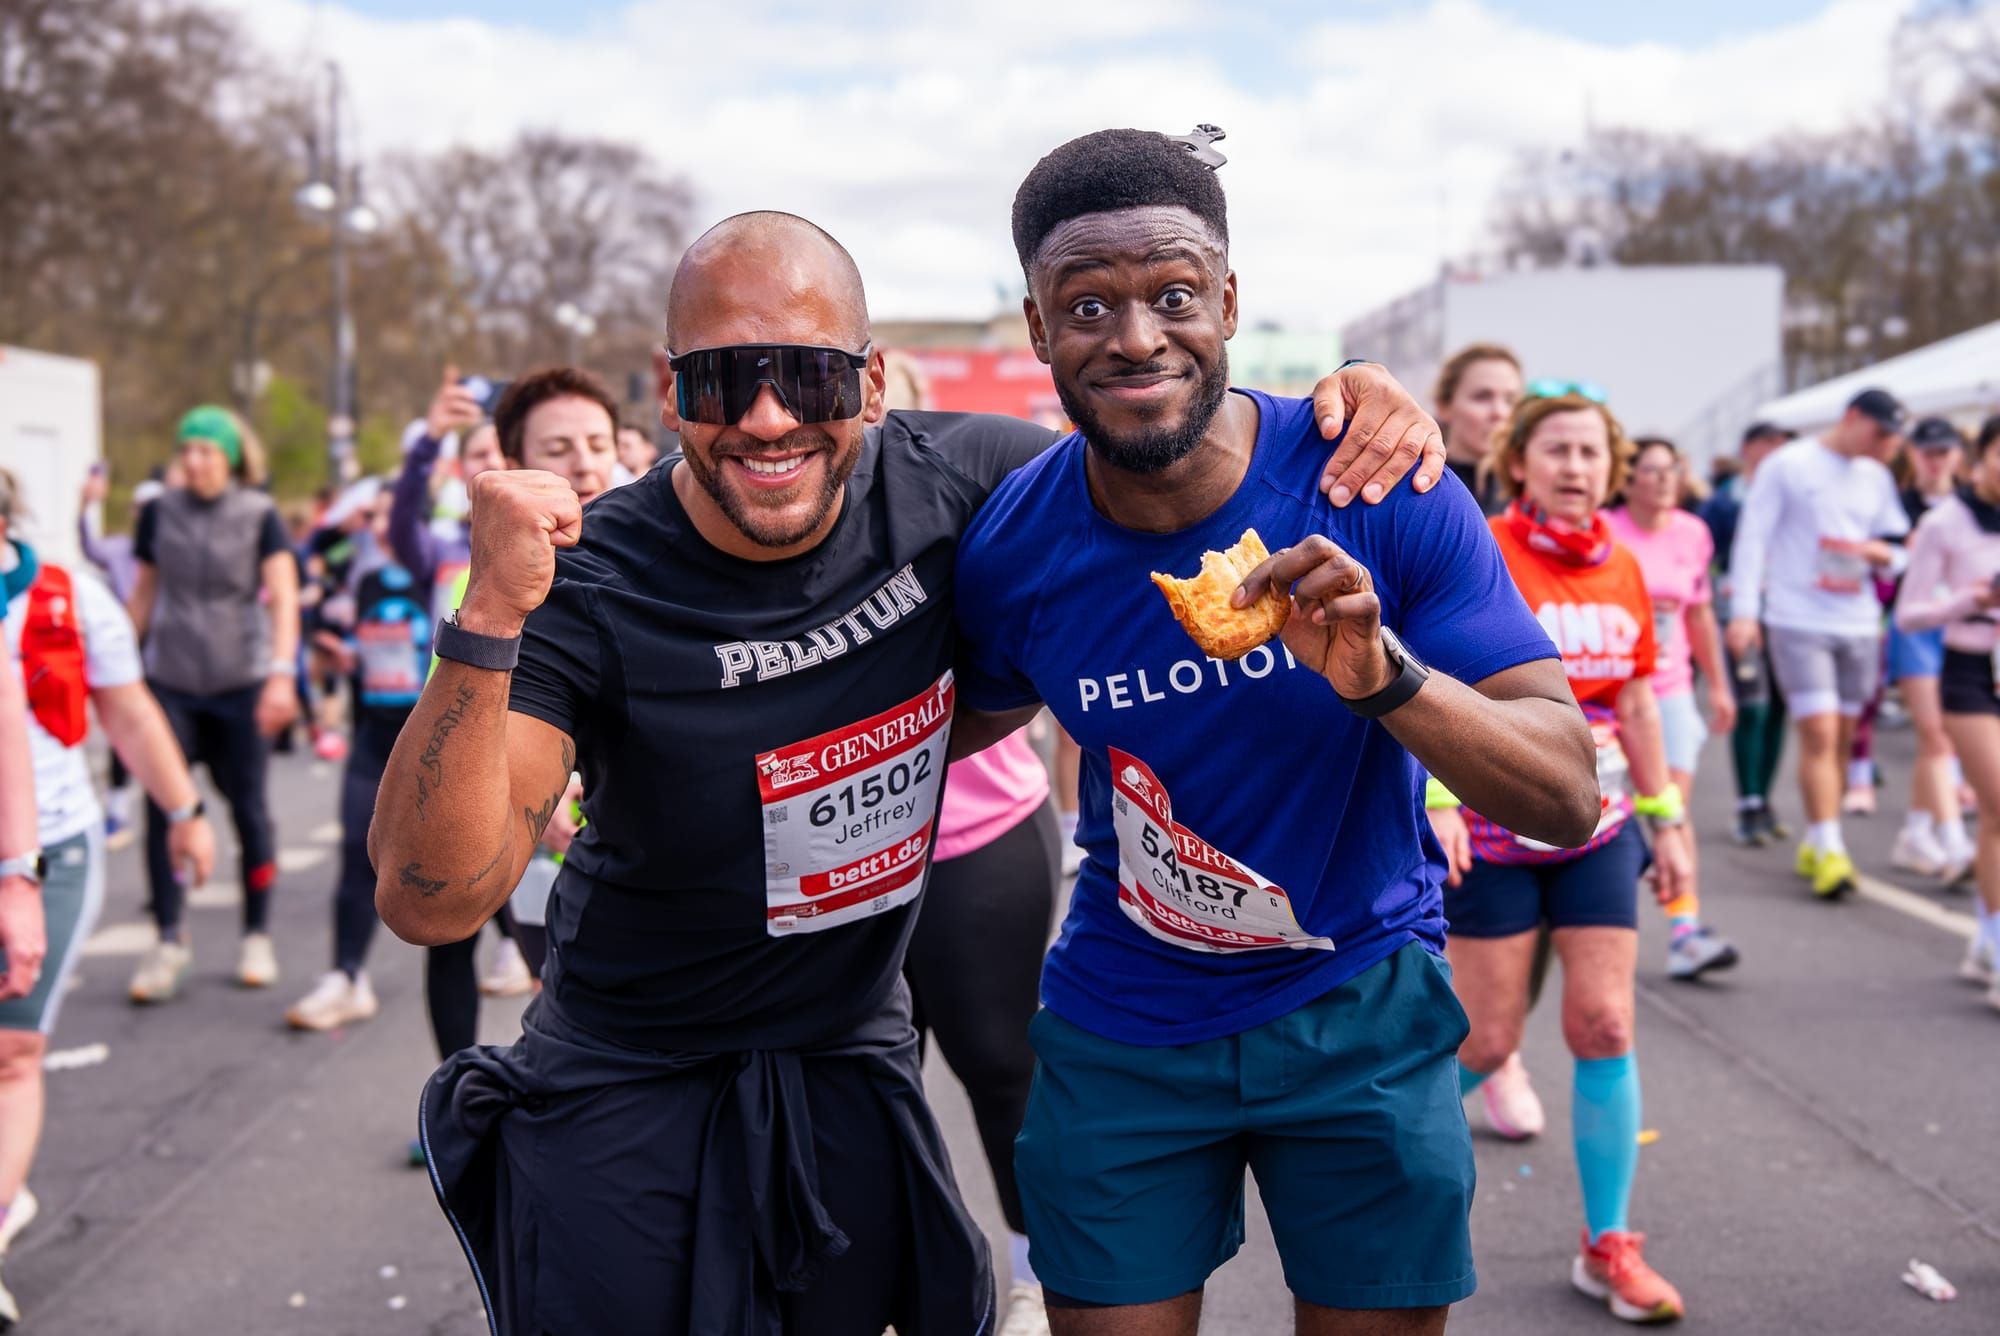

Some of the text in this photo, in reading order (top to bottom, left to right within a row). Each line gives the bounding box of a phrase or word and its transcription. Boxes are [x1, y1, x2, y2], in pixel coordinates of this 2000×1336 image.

[820, 690, 947, 773] GENERALI
[809, 748, 931, 827] 61502
[835, 796, 916, 844] Jeffrey
[828, 836, 922, 888] bett1.de
[1141, 822, 1249, 908] 54187
[1152, 867, 1236, 920] Clifford
[1153, 898, 1256, 943] bett1.de
